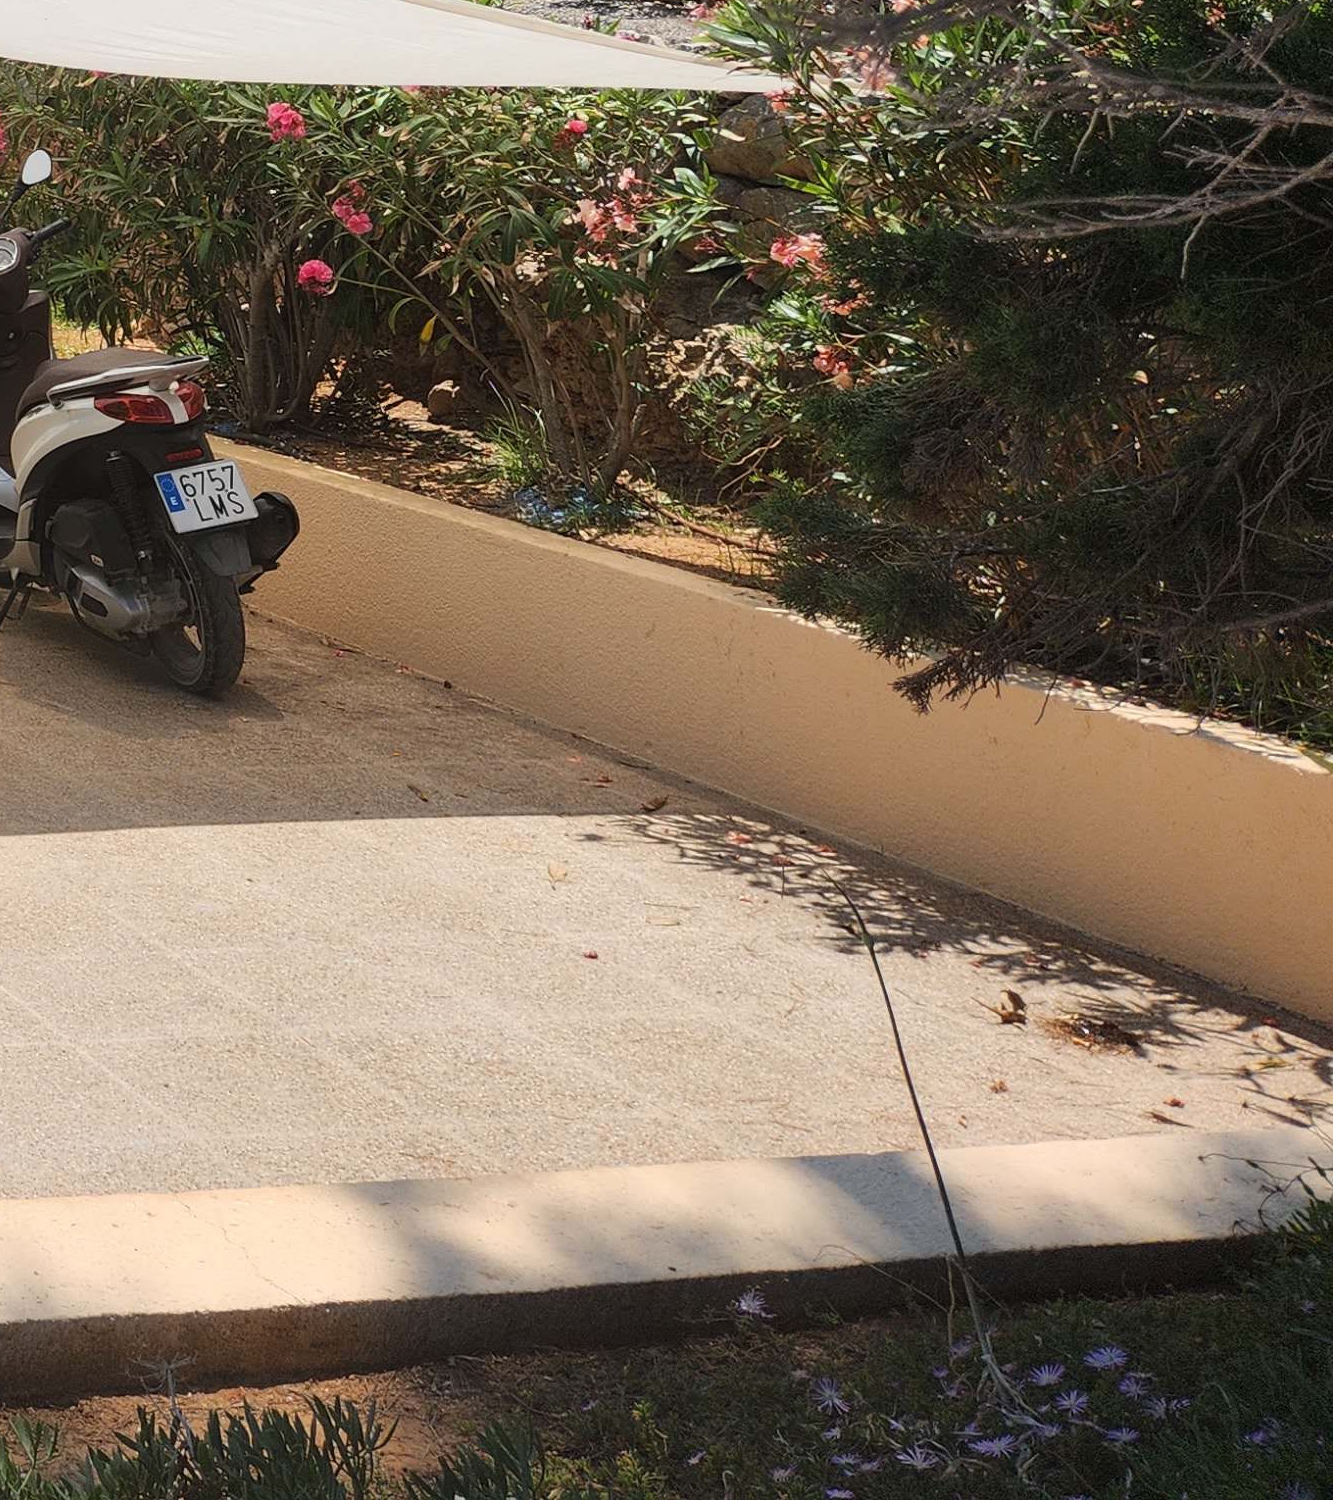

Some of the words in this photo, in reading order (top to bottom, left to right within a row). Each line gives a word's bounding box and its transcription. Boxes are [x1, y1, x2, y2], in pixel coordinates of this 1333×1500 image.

[178, 464, 234, 498] 6757
[169, 495, 179, 507] E
[192, 490, 245, 522] LMS
